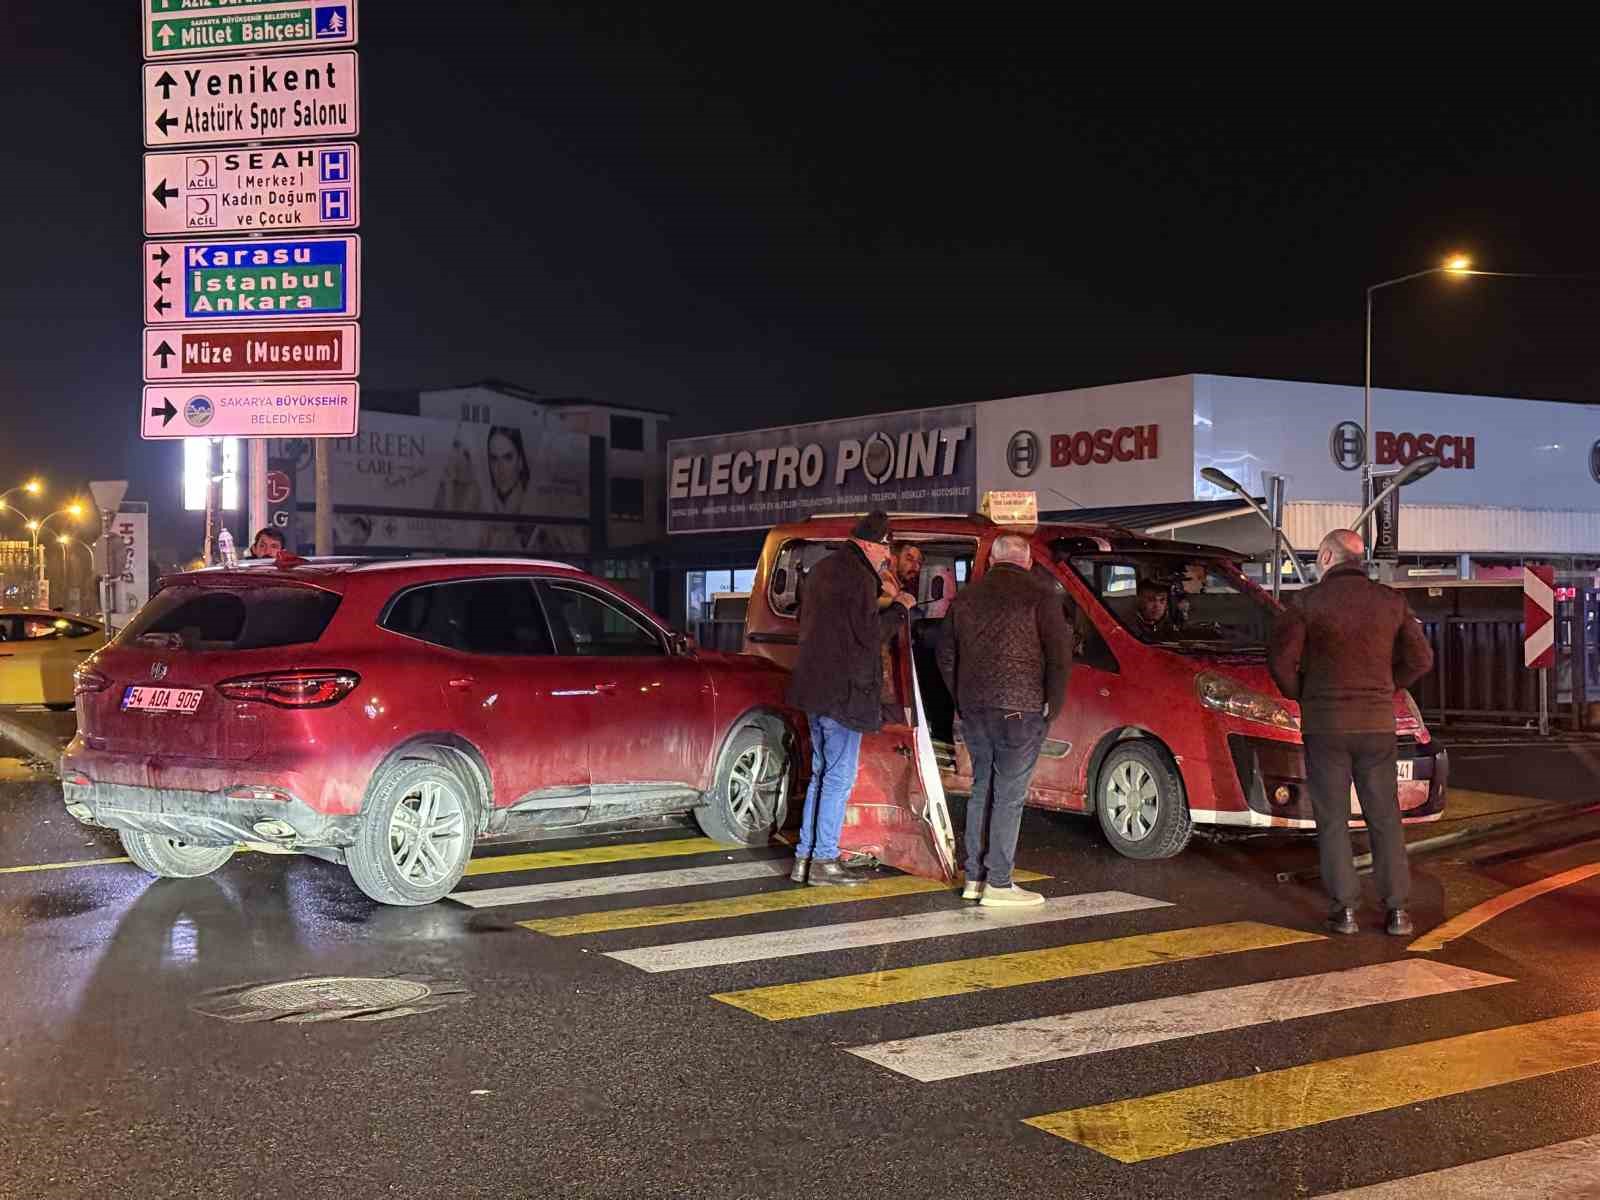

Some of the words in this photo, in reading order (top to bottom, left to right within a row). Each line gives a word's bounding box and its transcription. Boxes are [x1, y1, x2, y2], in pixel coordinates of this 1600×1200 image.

[181, 25, 233, 46] Millet
[242, 18, 310, 41] Bahçesi
[184, 62, 336, 97] Yenikent
[184, 103, 243, 133] Atatürk
[250, 103, 286, 136] Spor
[294, 99, 347, 127] Salonu
[225, 151, 314, 170] SEAH
[189, 178, 215, 188] ACİL
[222, 193, 262, 207] Kadın
[269, 190, 317, 206] Doğum
[189, 216, 215, 226] ACİL
[237, 213, 253, 225] ve
[260, 210, 302, 227] Çocuk
[188, 247, 311, 267] Karasu
[192, 270, 335, 292] İstanbul
[193, 294, 313, 312] Ankara
[185, 341, 233, 364] Müze
[246, 338, 339, 364] (Museum)
[220, 397, 273, 408] SAKARYA
[276, 394, 348, 407] BÜYÜKŞEHİR
[251, 411, 316, 424] BELEDİYESİ
[1050, 424, 1159, 467] BOSCH
[1375, 431, 1475, 469] BOSCH
[670, 444, 824, 499] ELECTRO
[835, 426, 969, 485] POINT
[129, 688, 143, 705] 54
[148, 689, 171, 707] ADA
[176, 691, 201, 709] 906
